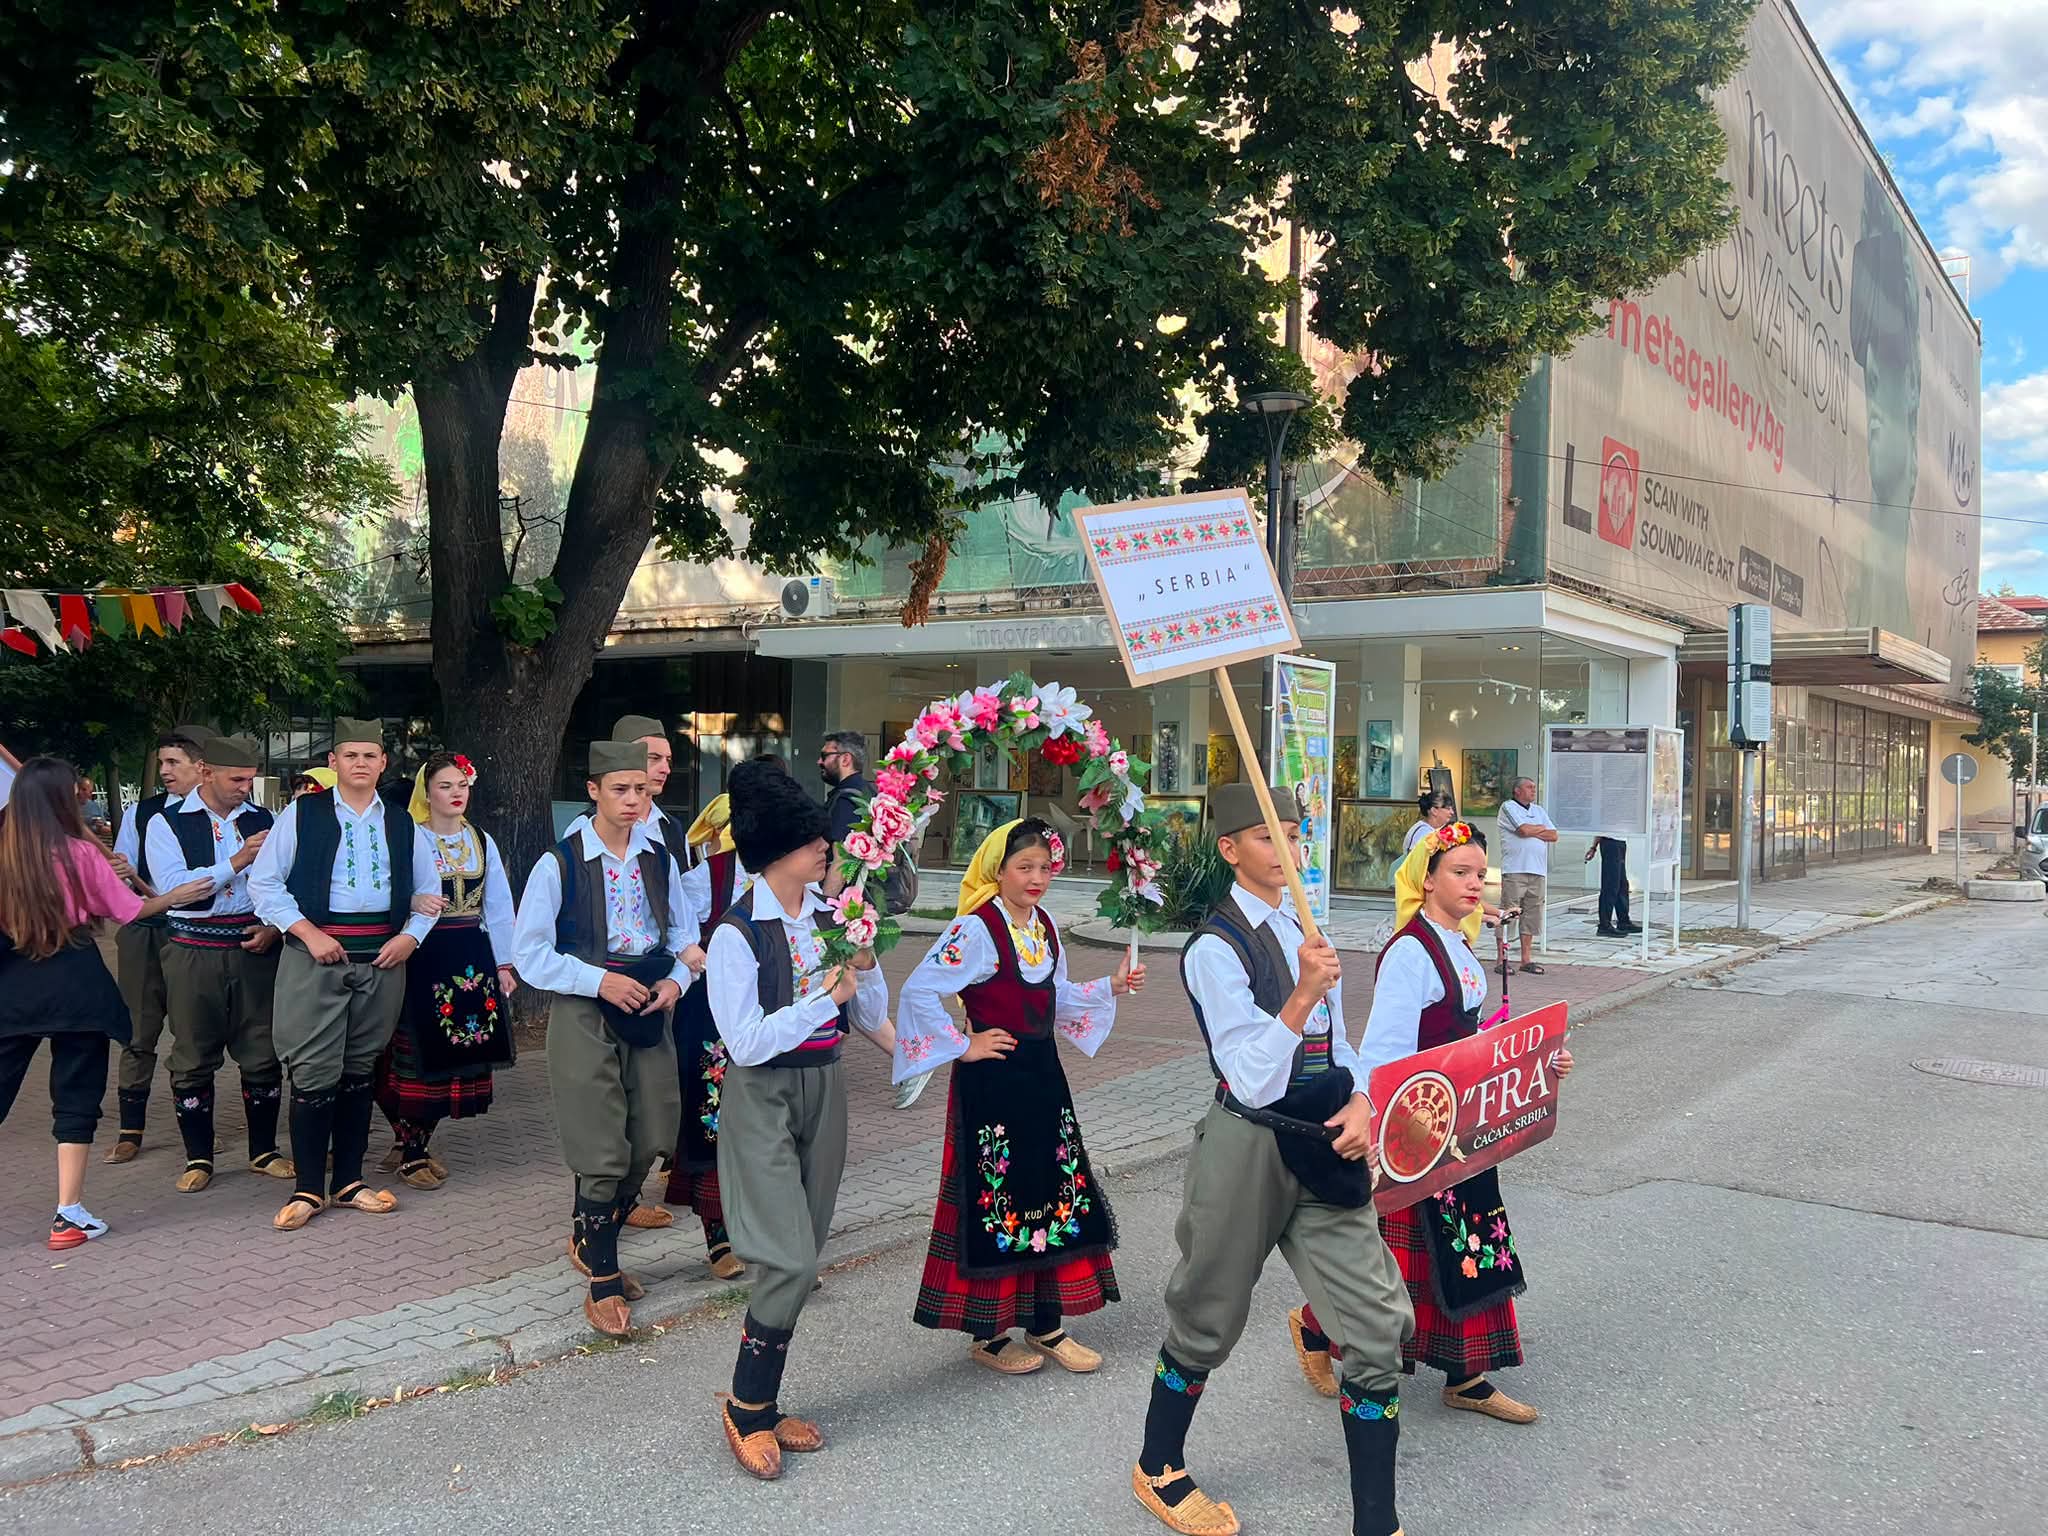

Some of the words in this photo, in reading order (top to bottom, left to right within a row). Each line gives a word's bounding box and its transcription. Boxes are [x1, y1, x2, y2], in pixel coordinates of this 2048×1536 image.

[1747, 90, 1844, 315] meets
[1608, 297, 1784, 474] metagallery.bg
[1644, 477, 1678, 517] SCAN
[1681, 496, 1709, 532] WITH
[1640, 520, 1714, 575] SOUNDWAVE
[1715, 554, 1735, 583] ART
[1491, 1024, 1545, 1069] KUD
[1514, 1105, 1548, 1130] SRBIJA
[1024, 1209, 1043, 1221] KUD
